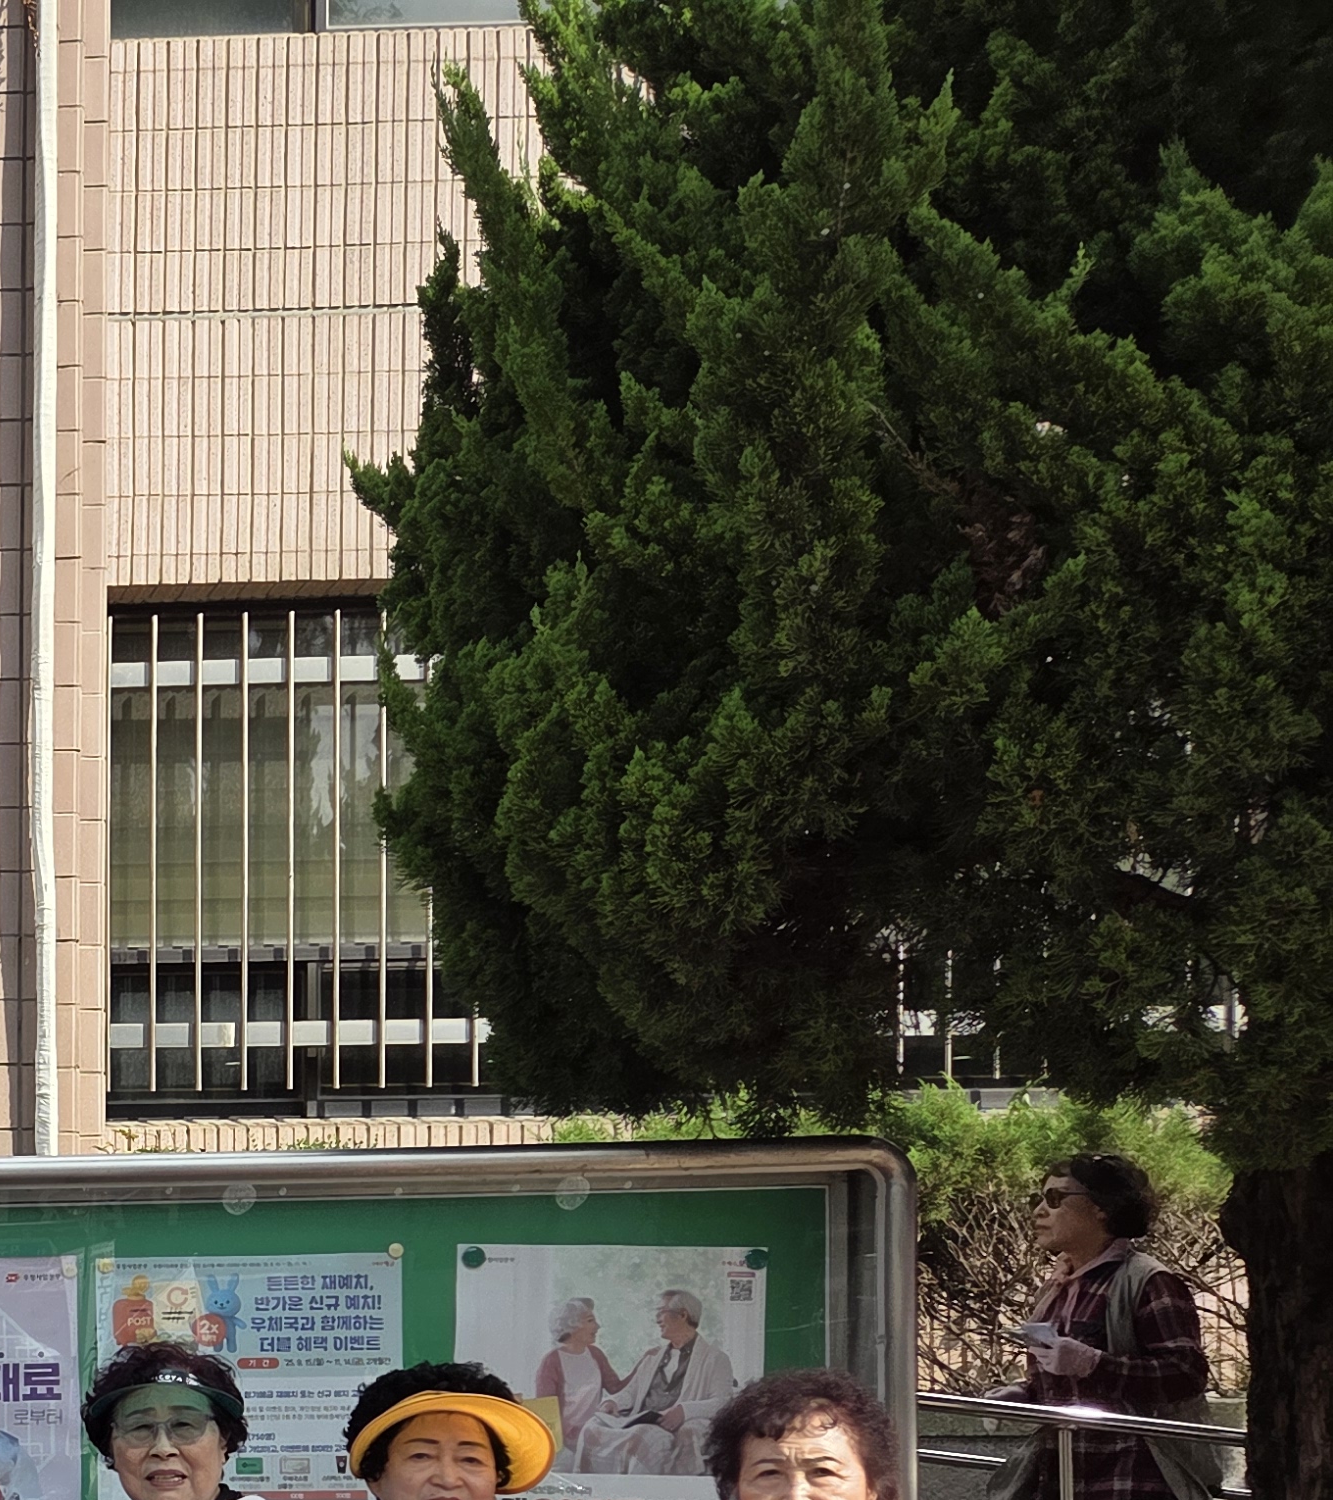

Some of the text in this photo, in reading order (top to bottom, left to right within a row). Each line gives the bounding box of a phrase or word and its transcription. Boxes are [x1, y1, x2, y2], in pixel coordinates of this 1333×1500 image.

[266, 1274, 316, 1291] 든든한
[254, 1294, 382, 1311] 반가운 신규 예치!
[127, 1316, 151, 1327] POST
[251, 1315, 384, 1332] 우체국과 함께하는
[296, 1336, 328, 1351] 혜택
[333, 1335, 381, 1351] 이벤트
[13, 1408, 63, 1426] 로부터
